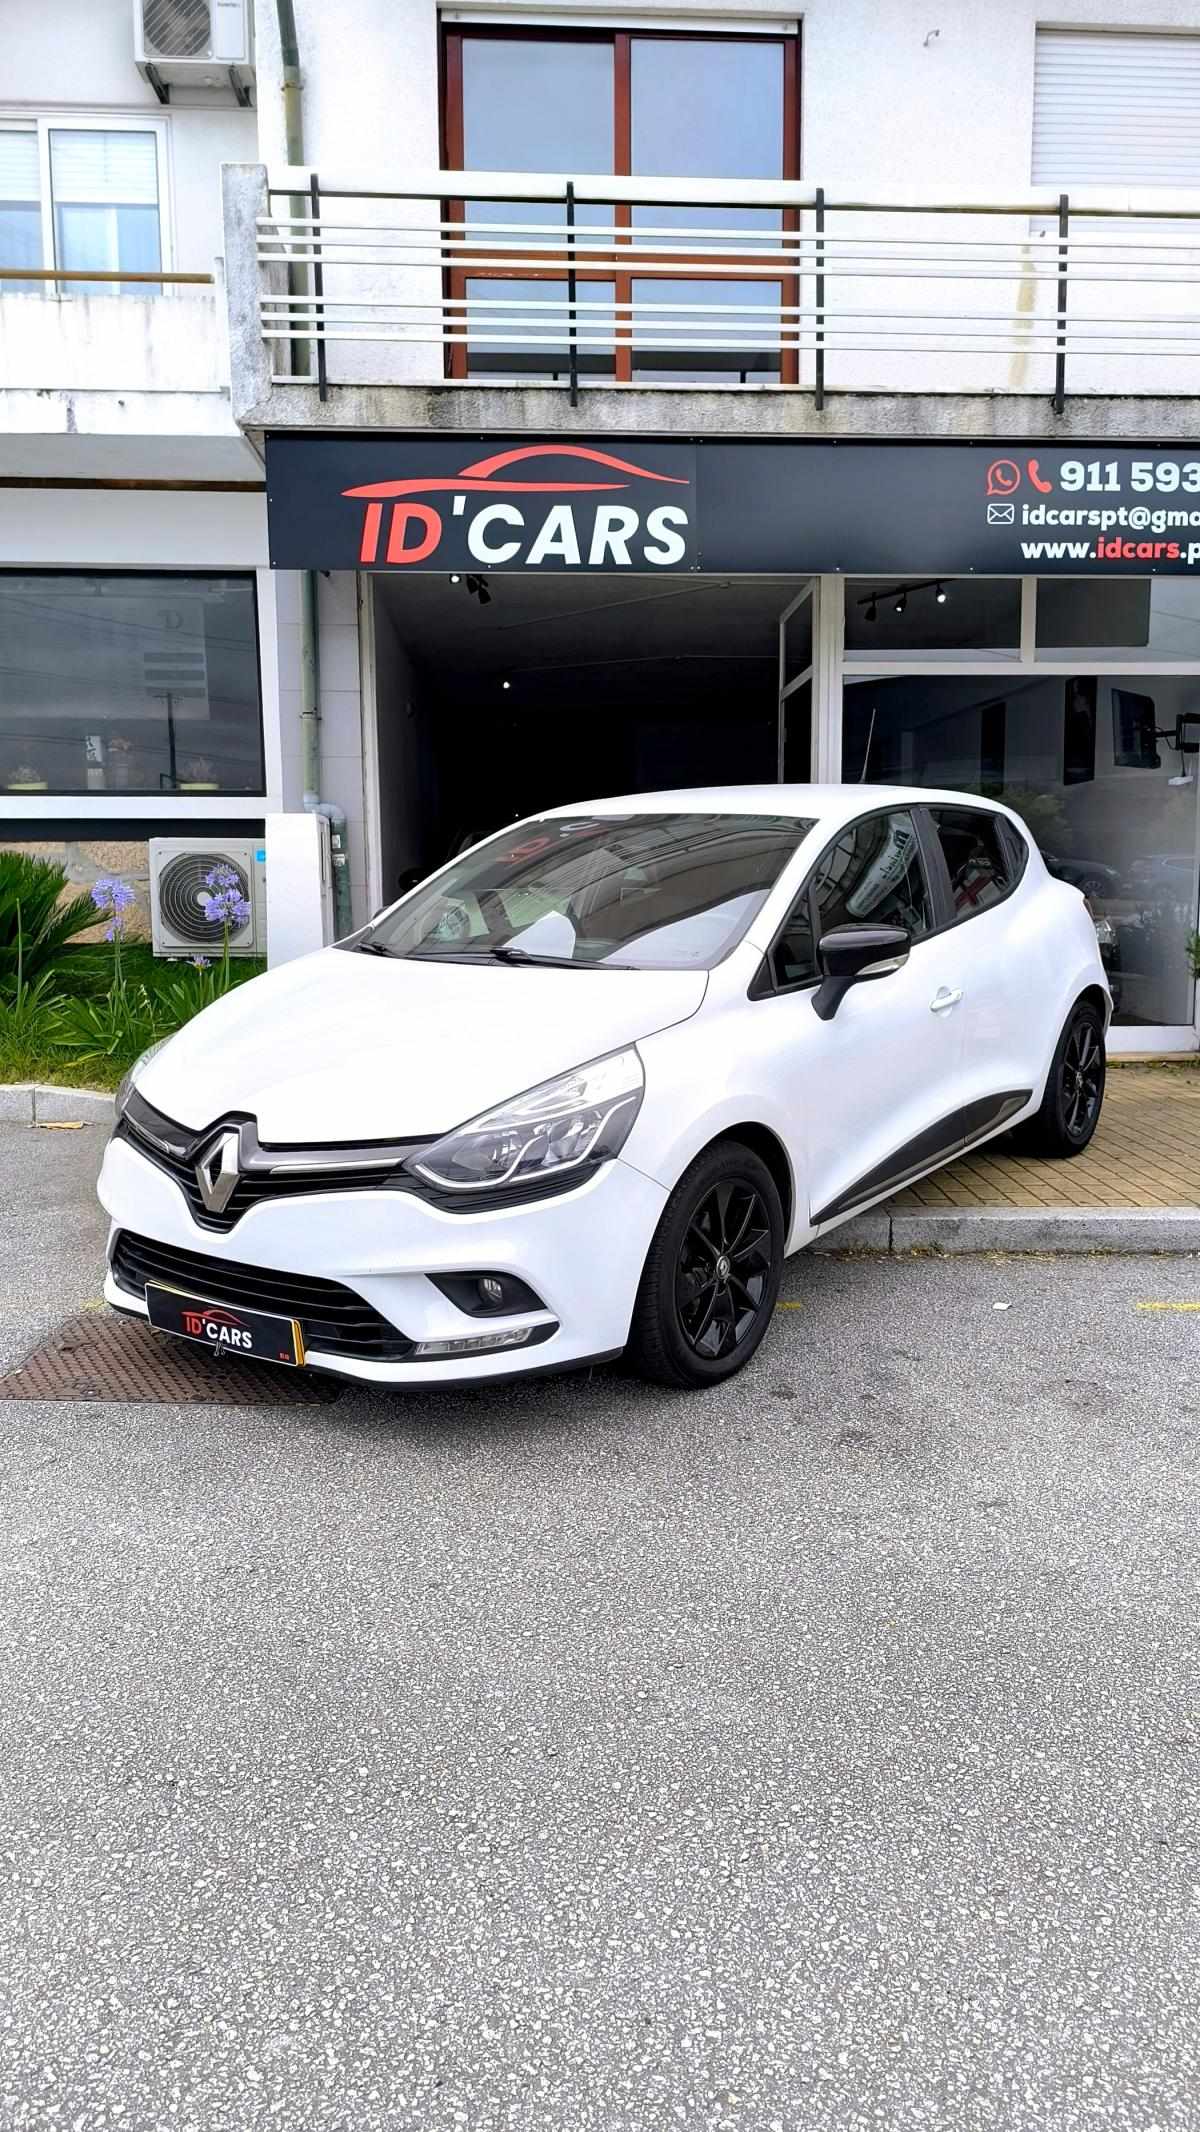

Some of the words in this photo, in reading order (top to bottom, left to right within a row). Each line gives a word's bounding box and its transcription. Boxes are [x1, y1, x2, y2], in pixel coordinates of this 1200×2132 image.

[1060, 461, 1121, 492] 911
[1130, 461, 1200, 492] 593
[360, 495, 689, 565] ID'CARS
[185, 1316, 252, 1349] ID'CARS
